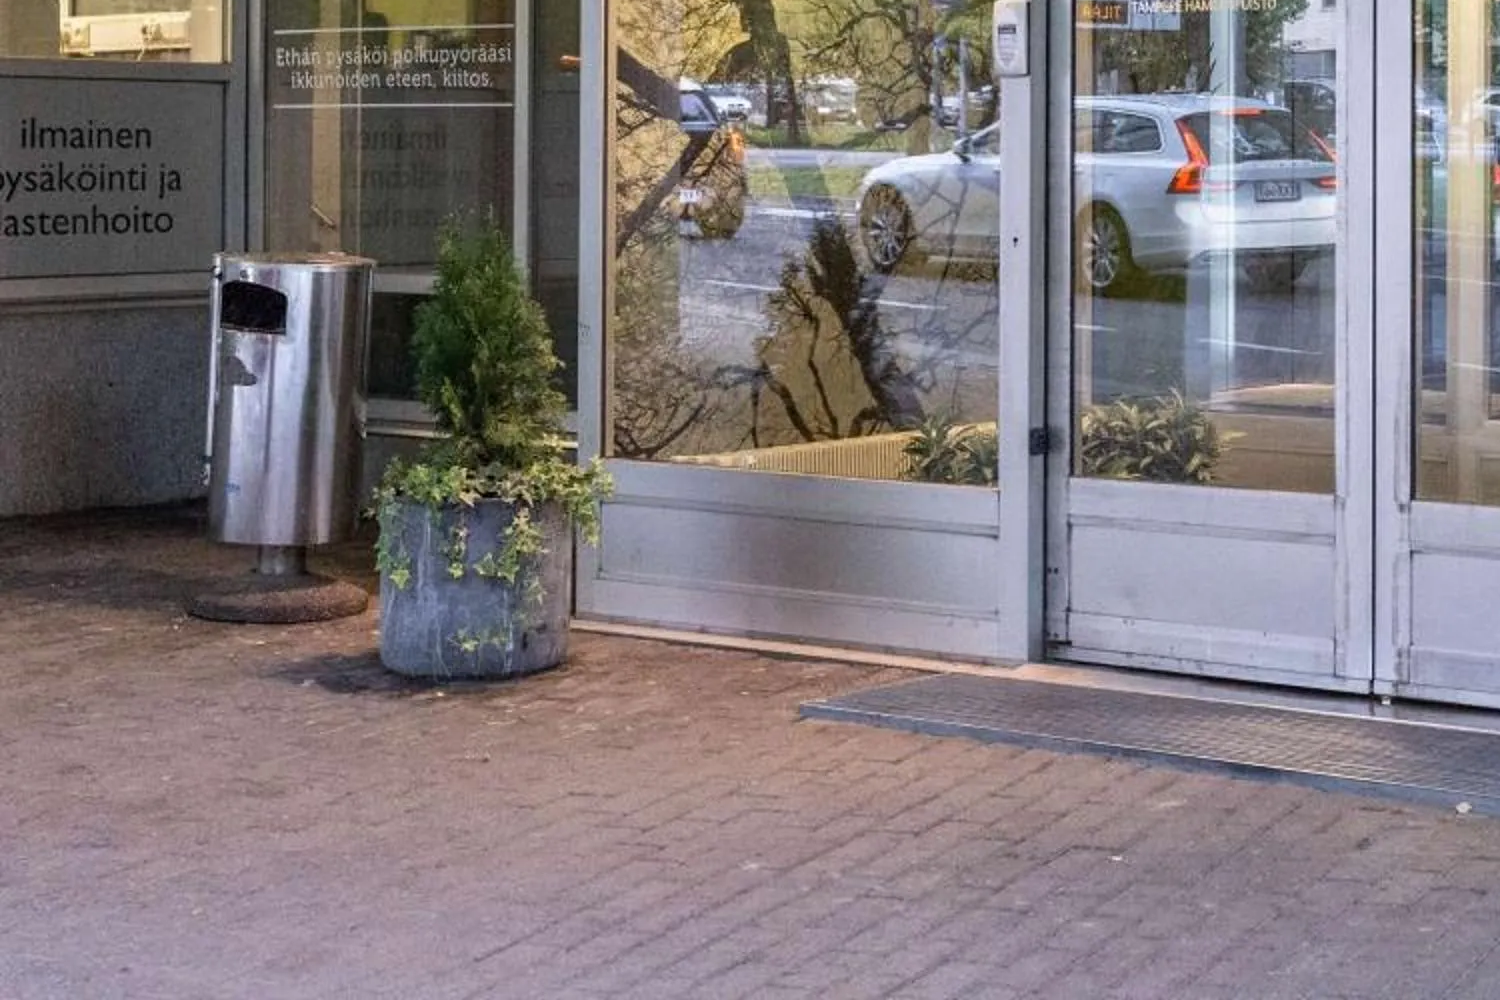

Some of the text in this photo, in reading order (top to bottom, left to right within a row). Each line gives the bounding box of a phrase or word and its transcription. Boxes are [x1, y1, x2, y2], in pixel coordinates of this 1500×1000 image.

[275, 40, 513, 69] Ethän pysäköi polkupyörääsi
[291, 69, 381, 89] ikkunoiden
[21, 117, 152, 149] ilmainen
[158, 162, 182, 199] ja
[0, 204, 174, 237] astenhoito
